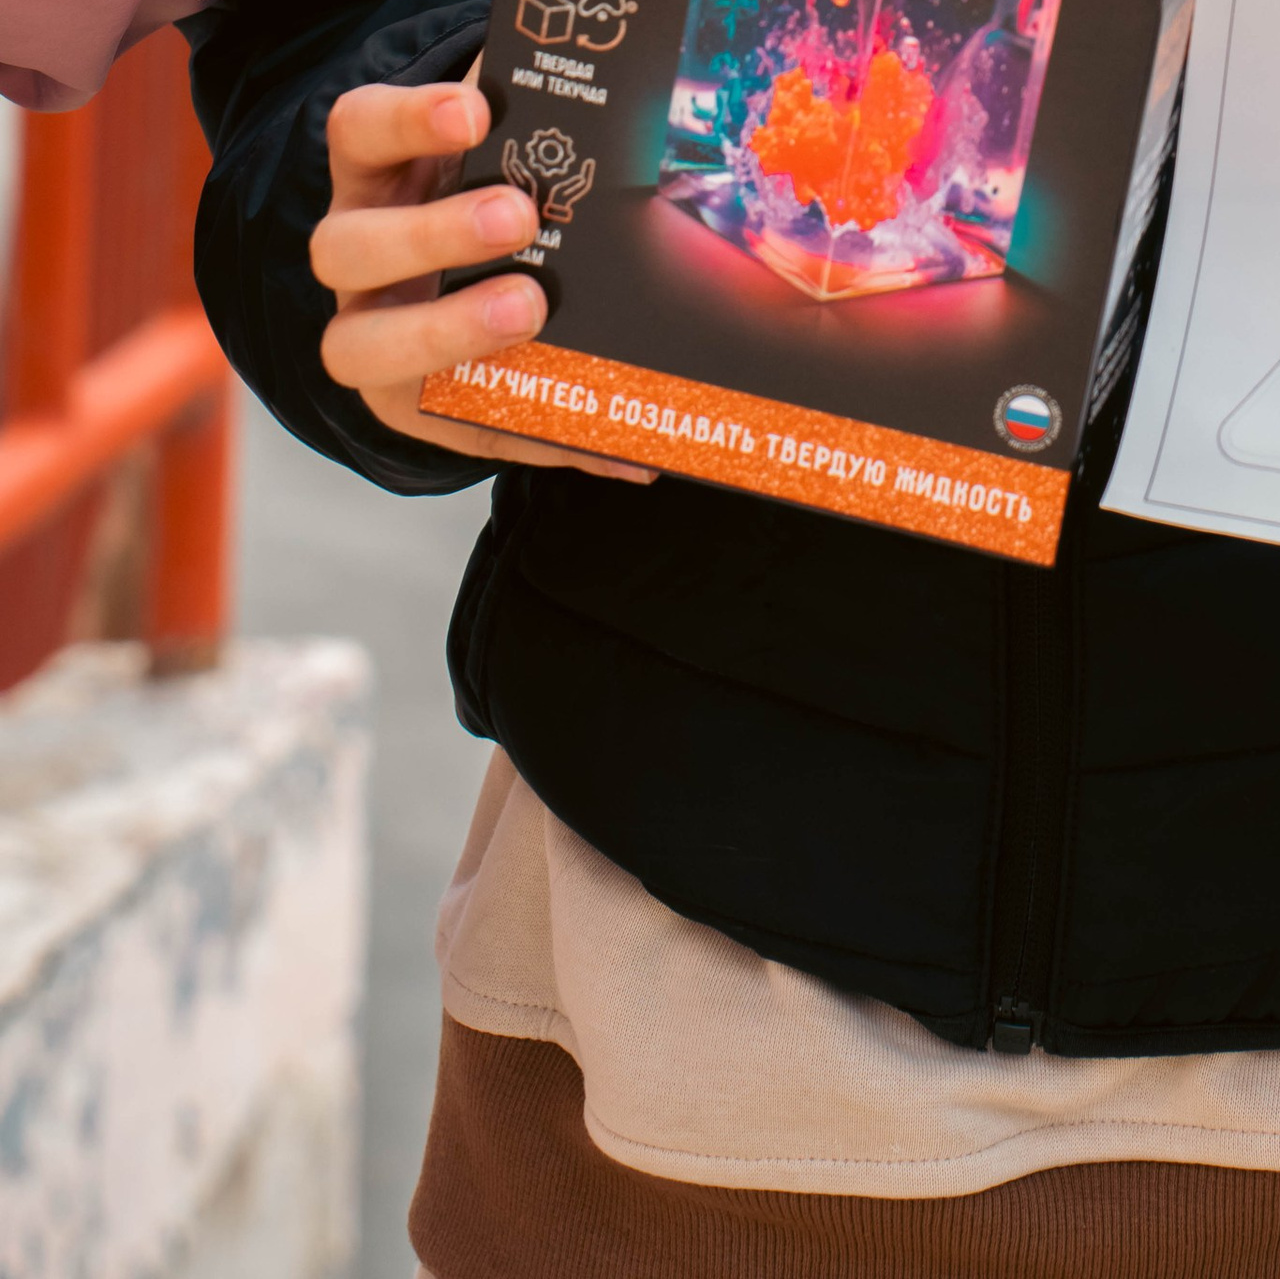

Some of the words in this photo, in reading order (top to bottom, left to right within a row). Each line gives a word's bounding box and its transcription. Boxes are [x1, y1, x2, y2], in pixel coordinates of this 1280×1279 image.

[533, 50, 596, 82] ТВЕРДАЯ
[511, 67, 544, 91] ИЛИ
[547, 75, 608, 107] ТЕКУЧАЯ
[453, 360, 600, 415] НАУЧИТЕСЬ
[607, 394, 756, 454] СОЗДАВАТЬ
[765, 432, 887, 487] ТВЕРДУЮ
[894, 466, 1032, 523] ЖИДКОСТЬ
